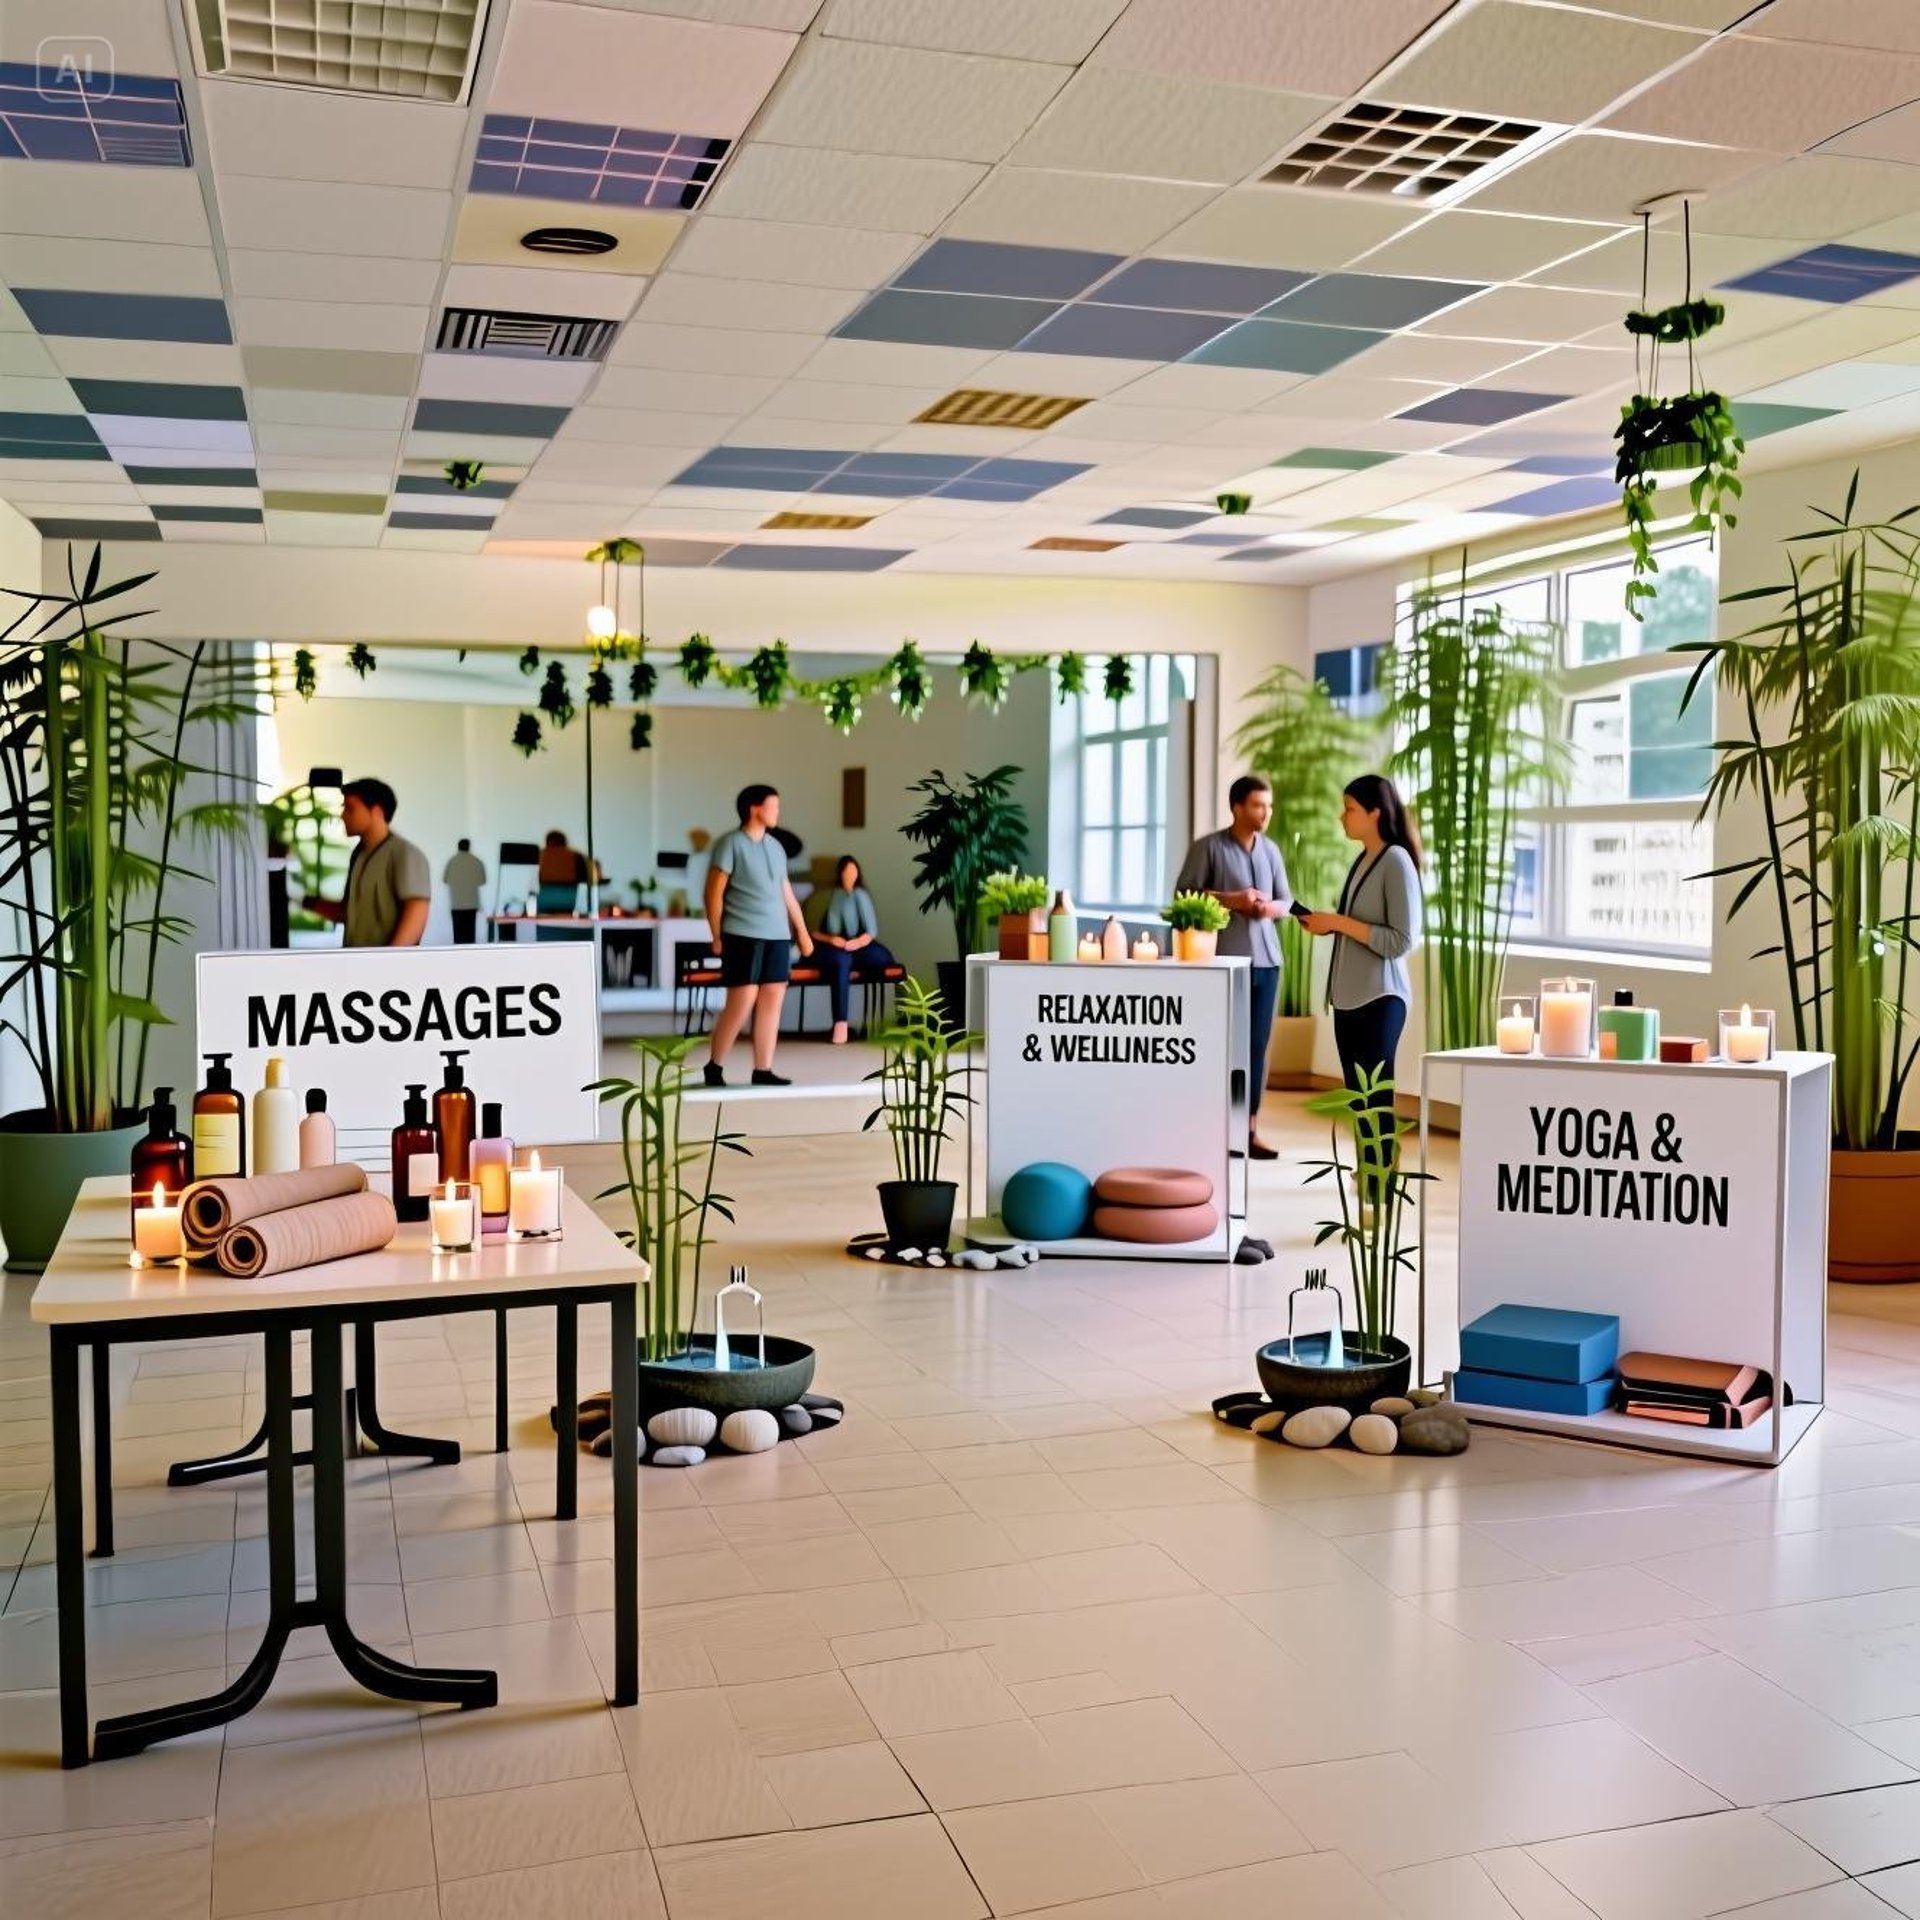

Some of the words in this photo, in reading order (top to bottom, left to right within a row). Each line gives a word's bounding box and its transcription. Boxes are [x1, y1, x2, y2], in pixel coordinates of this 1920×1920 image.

[248, 983, 562, 1048] MASSAGES
[1038, 994, 1182, 1025] RELAXATION
[1022, 1033, 1042, 1062] &
[1529, 1106, 1640, 1160] YOGA
[1650, 1112, 1684, 1163] &
[1497, 1162, 1729, 1228] MEDITATION
